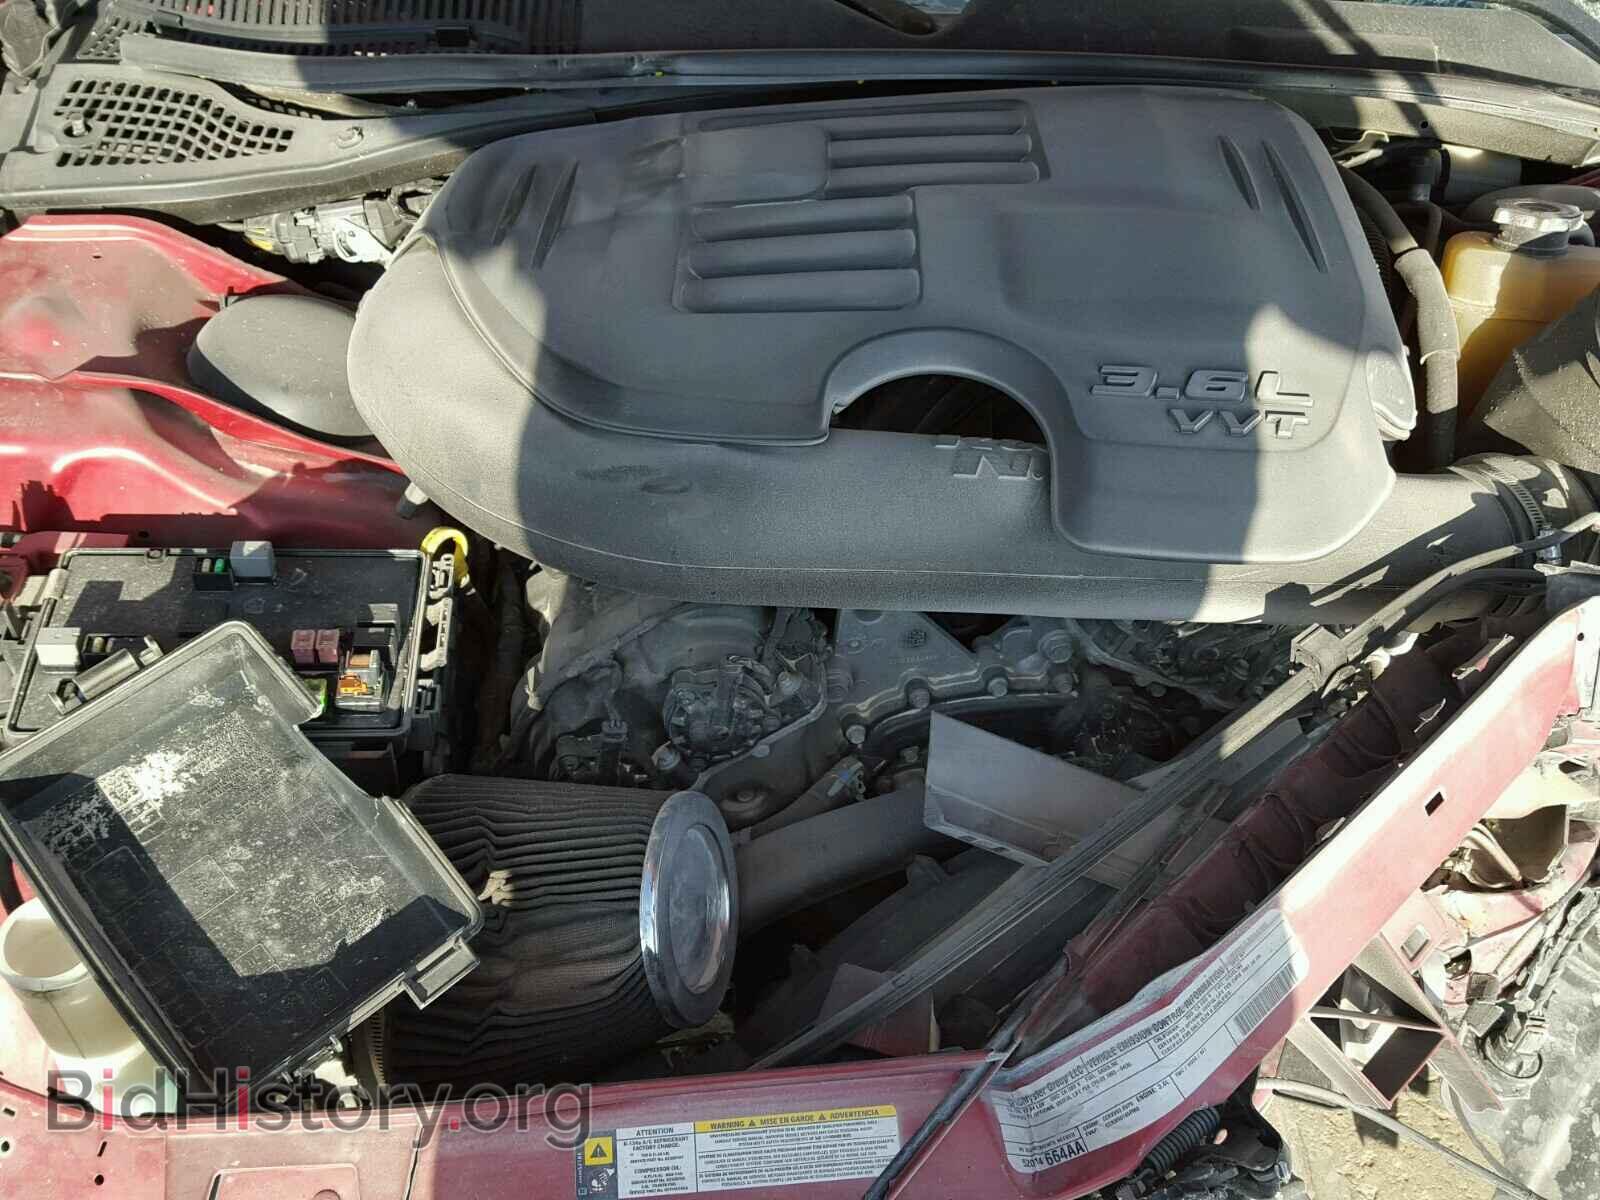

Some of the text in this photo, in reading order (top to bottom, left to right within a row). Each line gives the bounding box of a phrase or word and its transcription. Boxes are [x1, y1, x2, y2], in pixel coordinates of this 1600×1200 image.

[1091, 364, 1313, 408] 3.6L
[1168, 408, 1311, 440] VVT
[1116, 1026, 1152, 1052] EMISSION
[1150, 1005, 1185, 1032] CONTROL
[1183, 966, 1225, 1009] INFORMATION
[635, 1127, 673, 1136] ATTENTION
[710, 1120, 745, 1129] WARNING
[760, 1117, 782, 1126] MISE
[784, 1116, 795, 1124] EN
[797, 1115, 816, 1124] GARDE
[830, 1109, 880, 1120] ADVERTENCIA
[1043, 1139, 1084, 1166] 664AA
